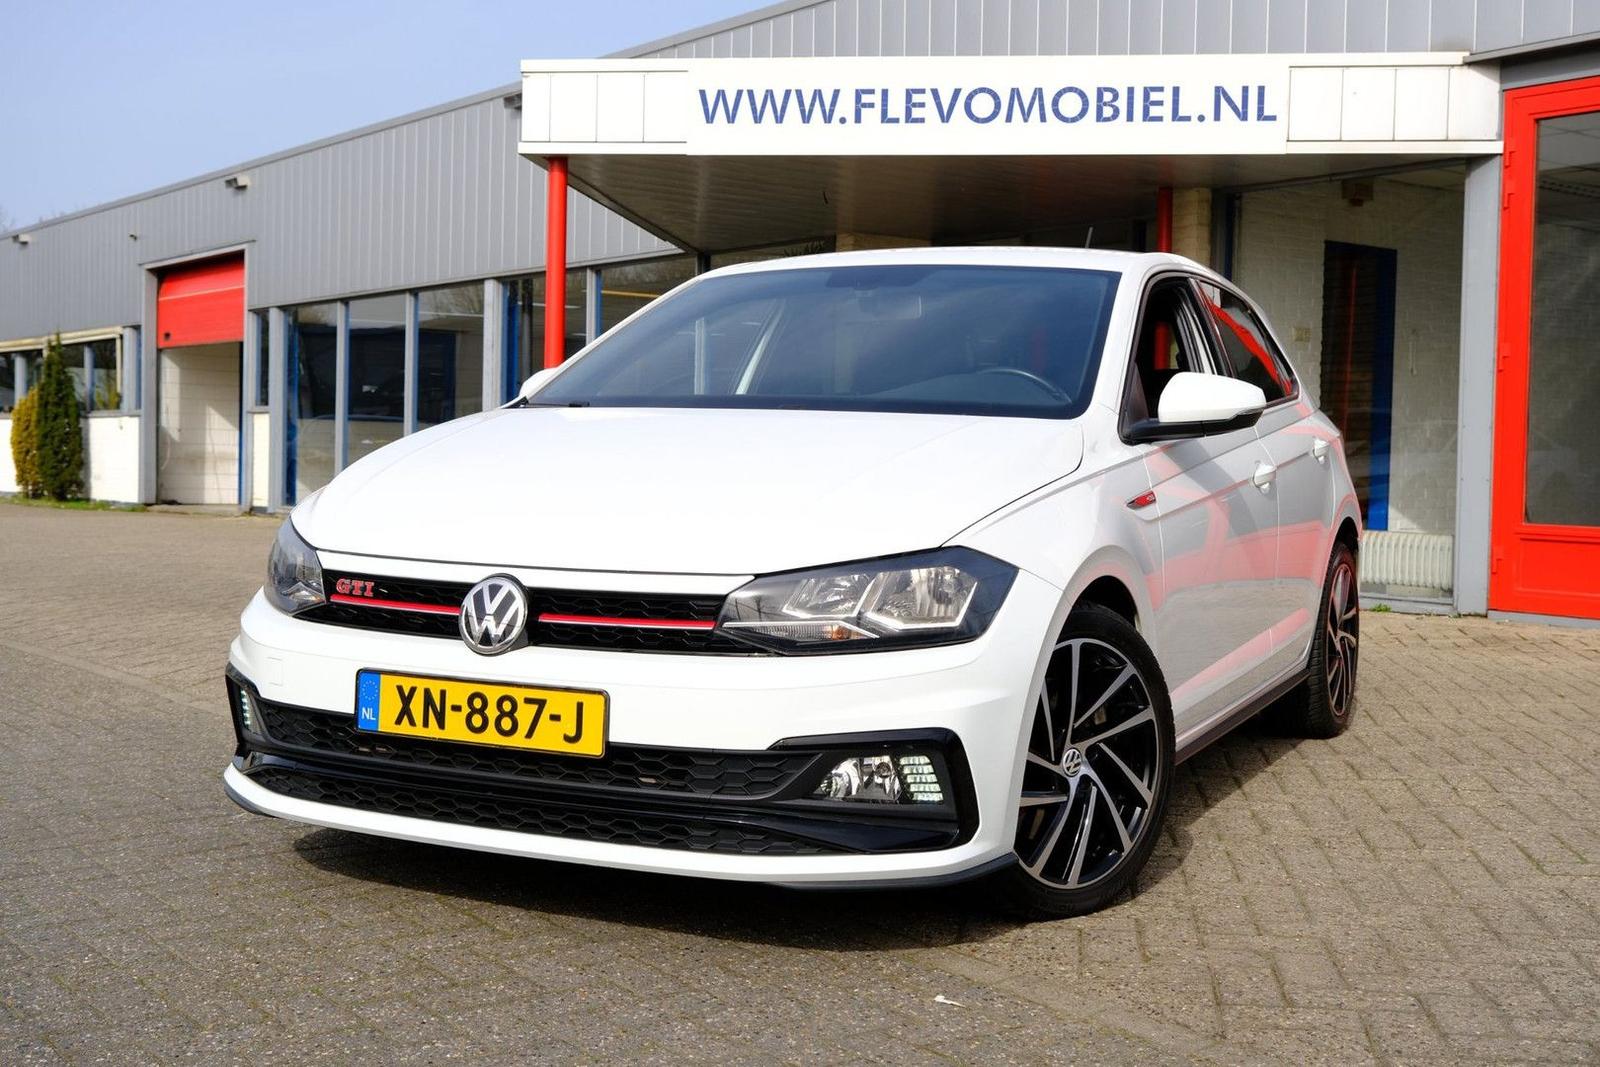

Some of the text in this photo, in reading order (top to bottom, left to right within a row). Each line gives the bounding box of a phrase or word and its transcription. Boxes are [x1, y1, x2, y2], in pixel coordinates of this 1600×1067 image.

[699, 85, 1277, 124] WWW.FLEVOMOBIEL.NL
[336, 578, 375, 597] GTI
[361, 707, 376, 720] NL
[394, 685, 584, 744] XN-887-J
